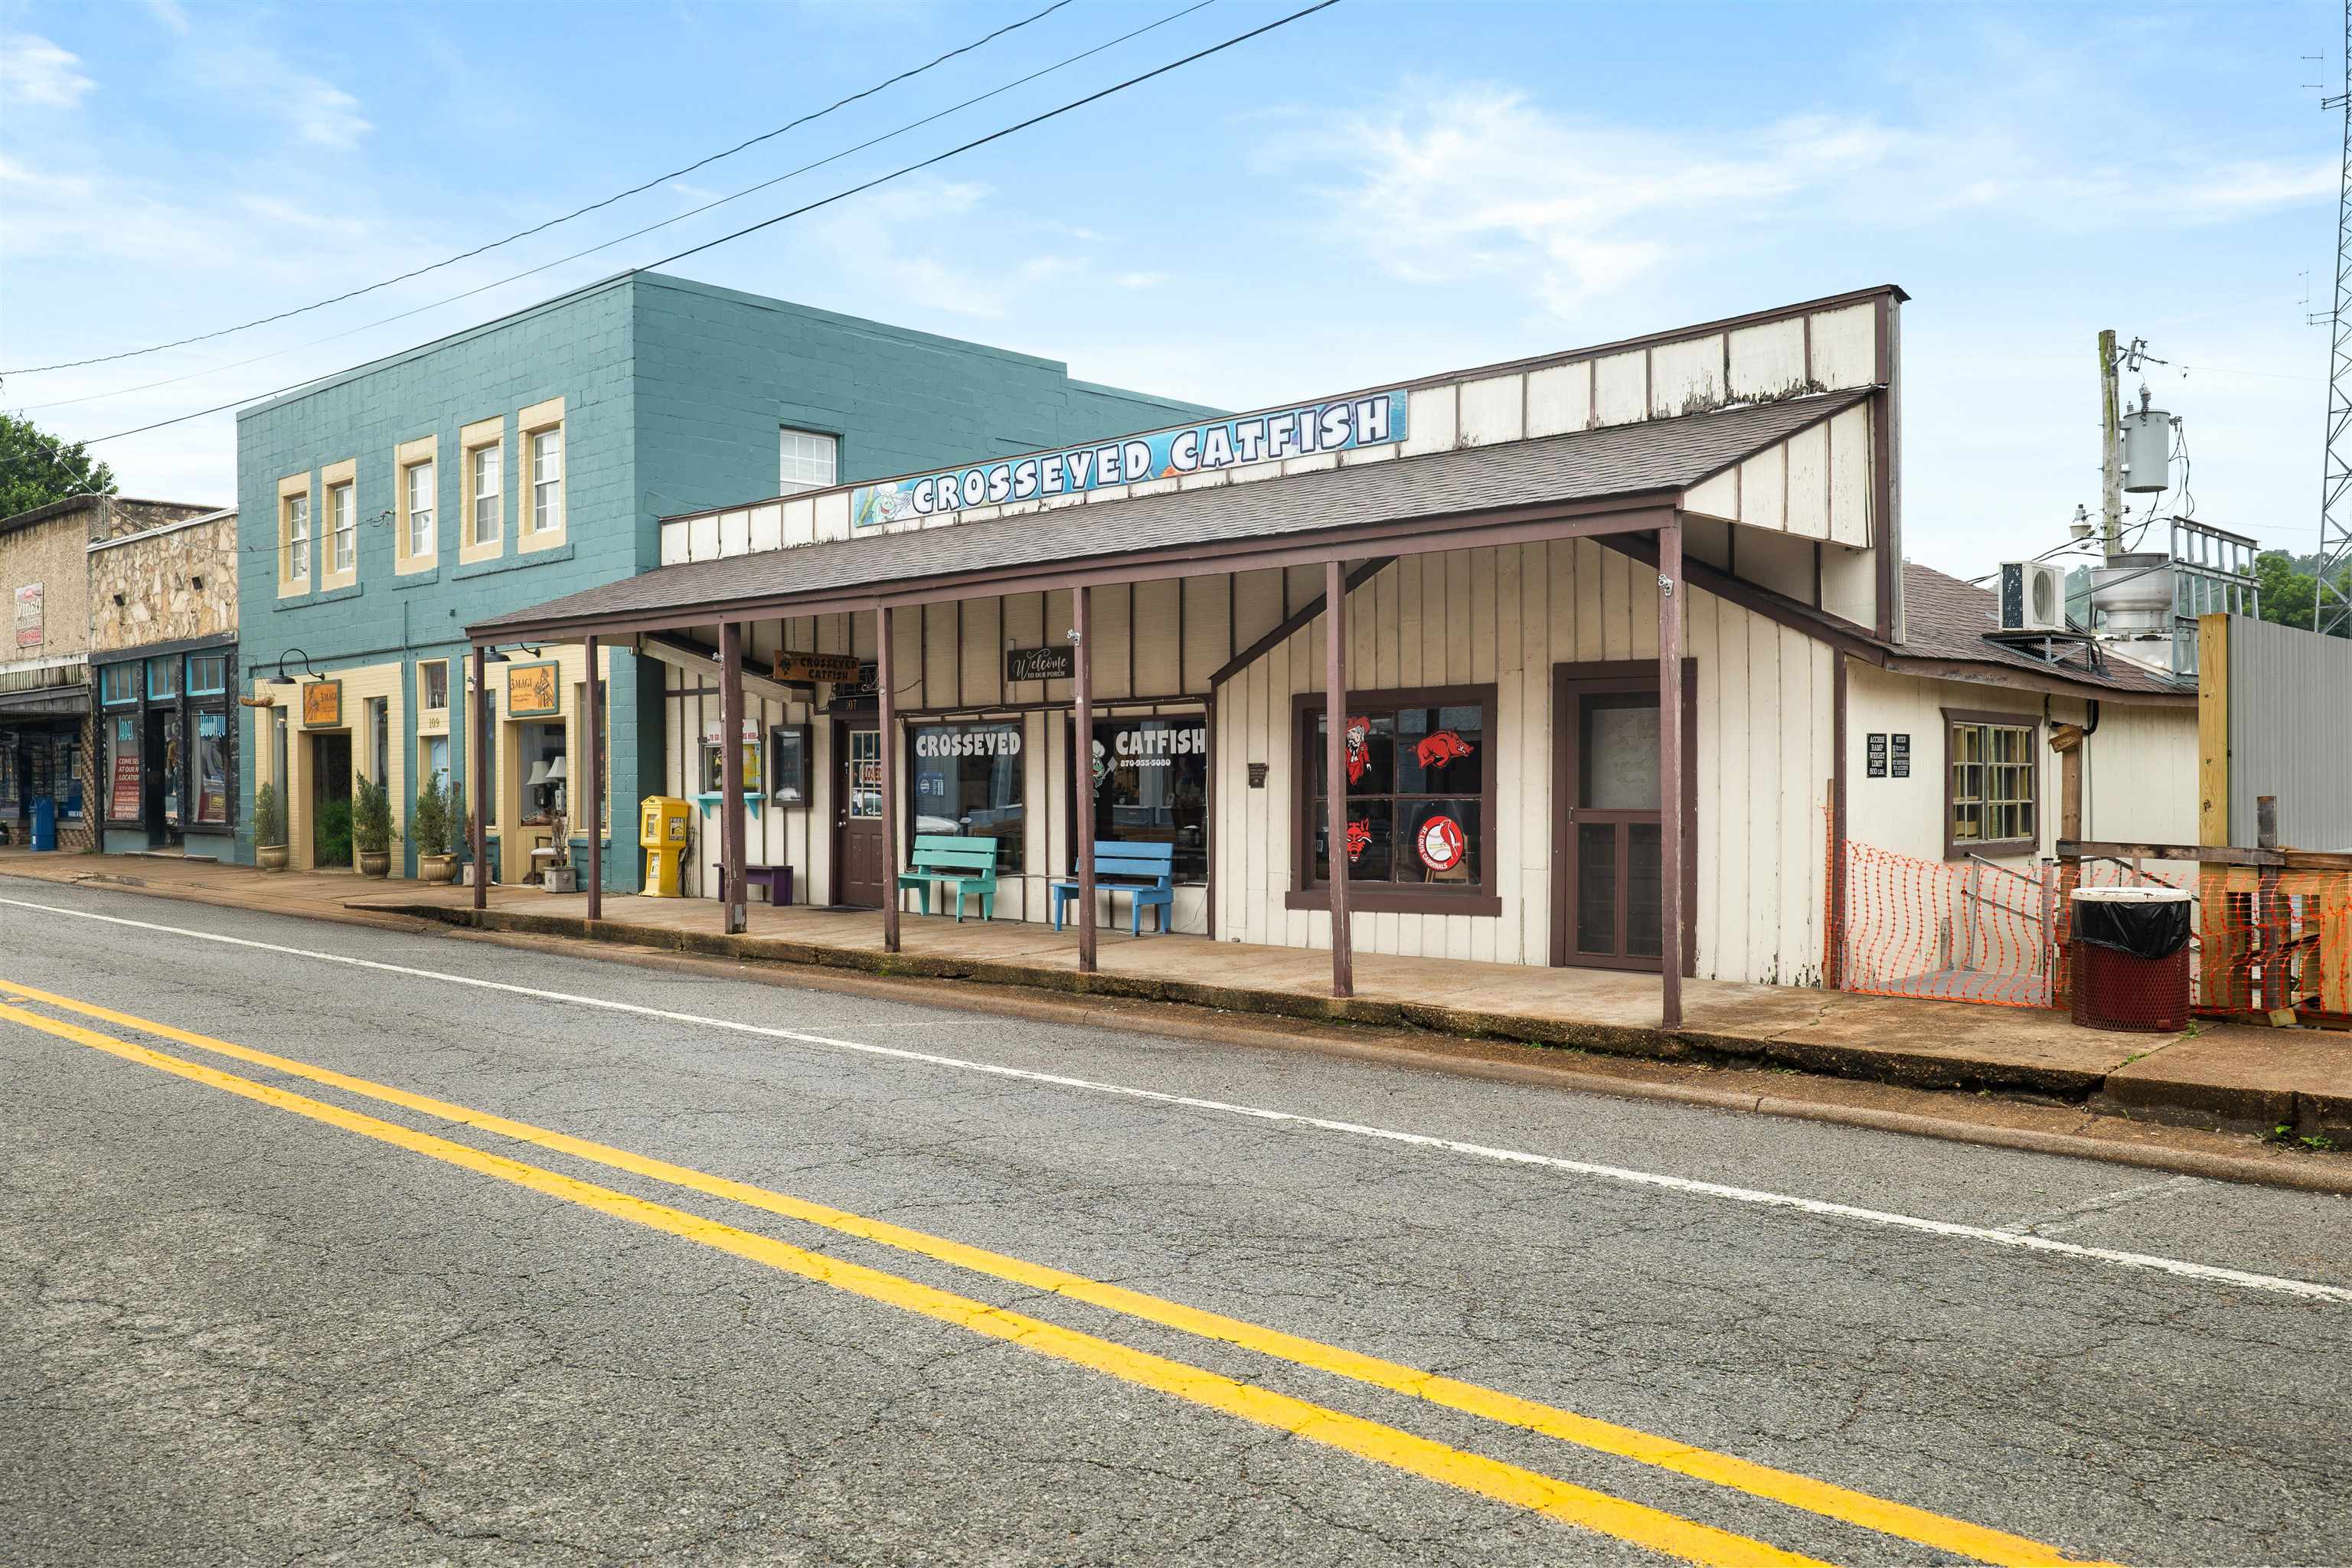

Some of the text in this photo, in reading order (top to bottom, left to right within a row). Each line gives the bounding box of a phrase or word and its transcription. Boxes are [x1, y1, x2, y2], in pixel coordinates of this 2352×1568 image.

[912, 395, 1390, 514] CROSSEYED CATFISH
[17, 598, 41, 619] VIDEO
[800, 657, 857, 670] CROSSEYED
[1012, 648, 1067, 680] Welcome
[808, 669, 849, 681] CATFISH
[510, 678, 532, 691] 3 MAGI
[199, 710, 226, 738] BOUTIQU
[429, 717, 440, 728] 109
[916, 731, 1021, 757] CROSSEYED
[1116, 728, 1206, 756] CATFISH
[861, 767, 881, 782] LOSED
[1423, 853, 1448, 869] CARDINALS
